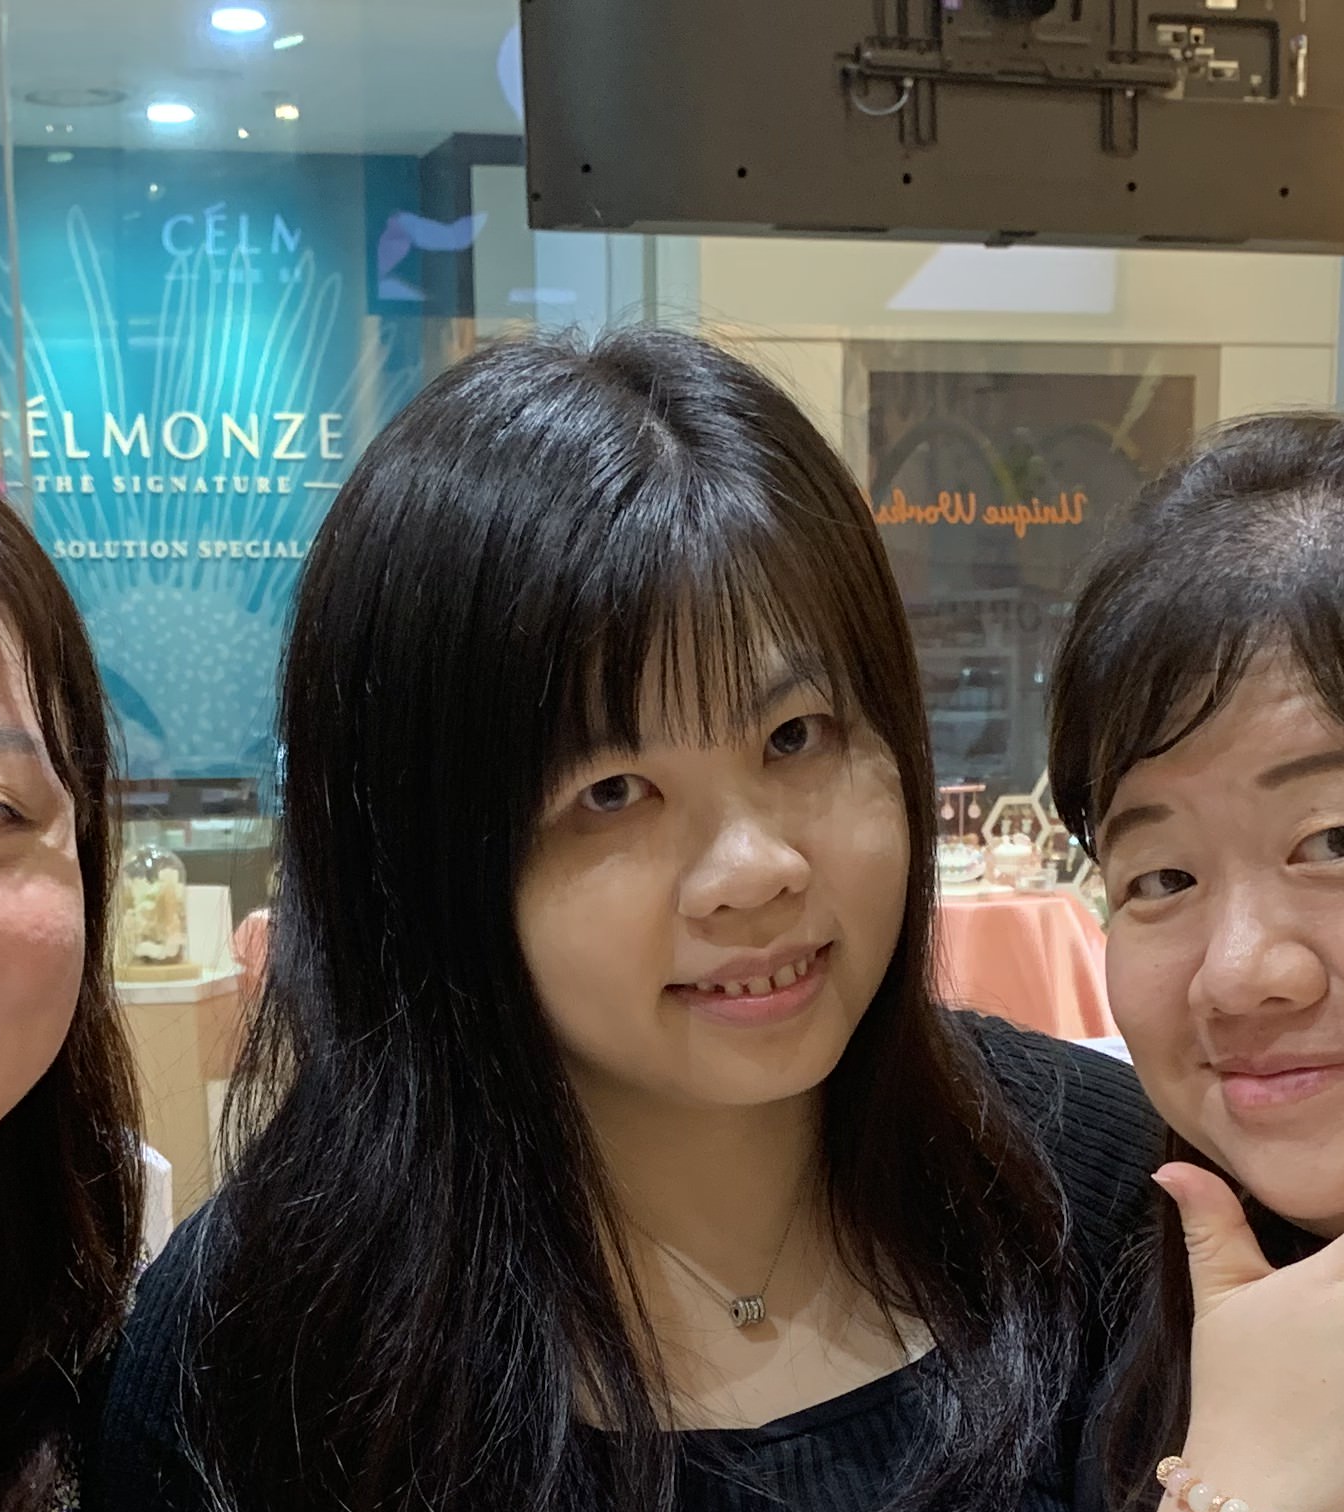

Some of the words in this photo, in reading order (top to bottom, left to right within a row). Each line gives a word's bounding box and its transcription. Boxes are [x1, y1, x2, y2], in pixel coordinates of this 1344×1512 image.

[0, 395, 344, 461] ÉLMONZE
[36, 475, 94, 494] THE
[113, 475, 292, 494] SIGNATURE
[54, 540, 189, 559] SOLUTION
[198, 540, 311, 559] SPECIAL
